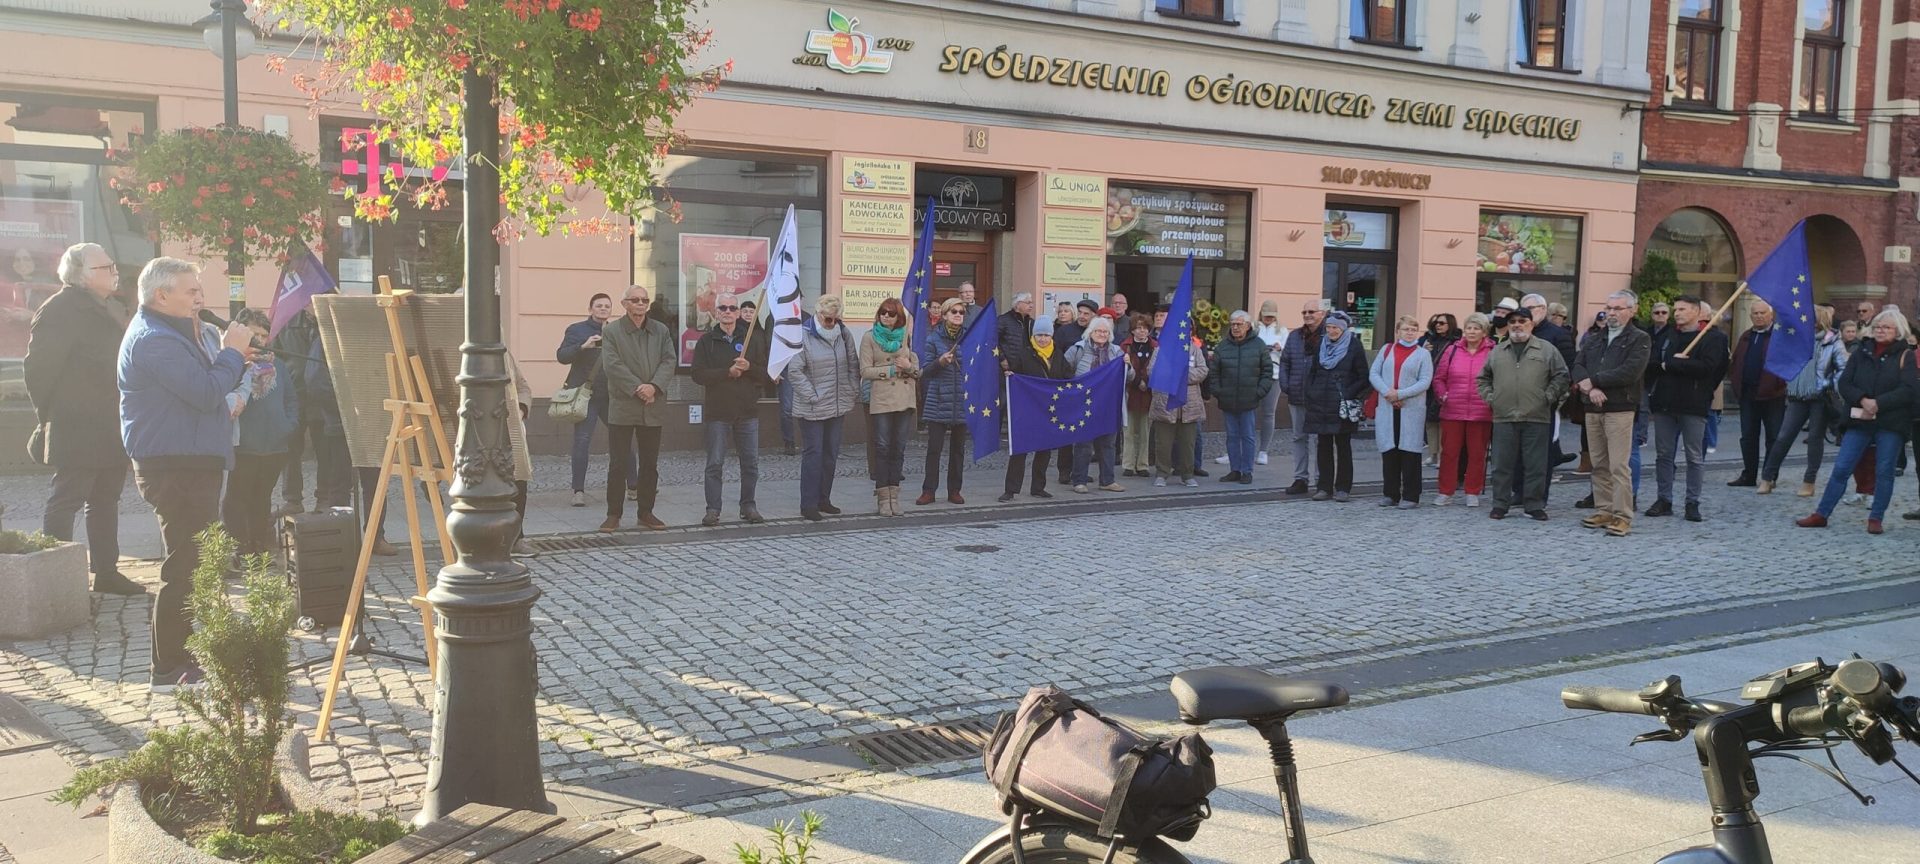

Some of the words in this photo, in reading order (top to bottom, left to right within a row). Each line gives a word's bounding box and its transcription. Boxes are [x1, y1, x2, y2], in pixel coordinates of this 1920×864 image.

[878, 38, 915, 51] 1907
[939, 44, 1170, 97] SPÓŁDZIELNIA
[1186, 74, 1374, 118] OGRODNICZA
[1385, 98, 1456, 127] ZIEMI
[1463, 107, 1582, 141] SĄDECKIEJ
[967, 129, 986, 149] 18
[1321, 166, 1358, 184] SKLEP
[1359, 168, 1431, 190] SPOŻYWCZY
[1069, 182, 1101, 193] UNIQA
[849, 201, 904, 212] KANCELARIA
[1174, 198, 1225, 212] spożywcze
[849, 209, 905, 220] ADWOKACKA
[983, 212, 1007, 226] RAJ
[1164, 215, 1225, 228] monopolowe
[714, 252, 732, 262] 200
[734, 253, 748, 263] GB
[1139, 245, 1171, 255] owoce
[1174, 243, 1178, 255] i
[1180, 247, 1224, 259] warzywa
[726, 269, 740, 281] 45
[847, 264, 888, 274] OPTIMUM
[846, 289, 860, 298] BAR
